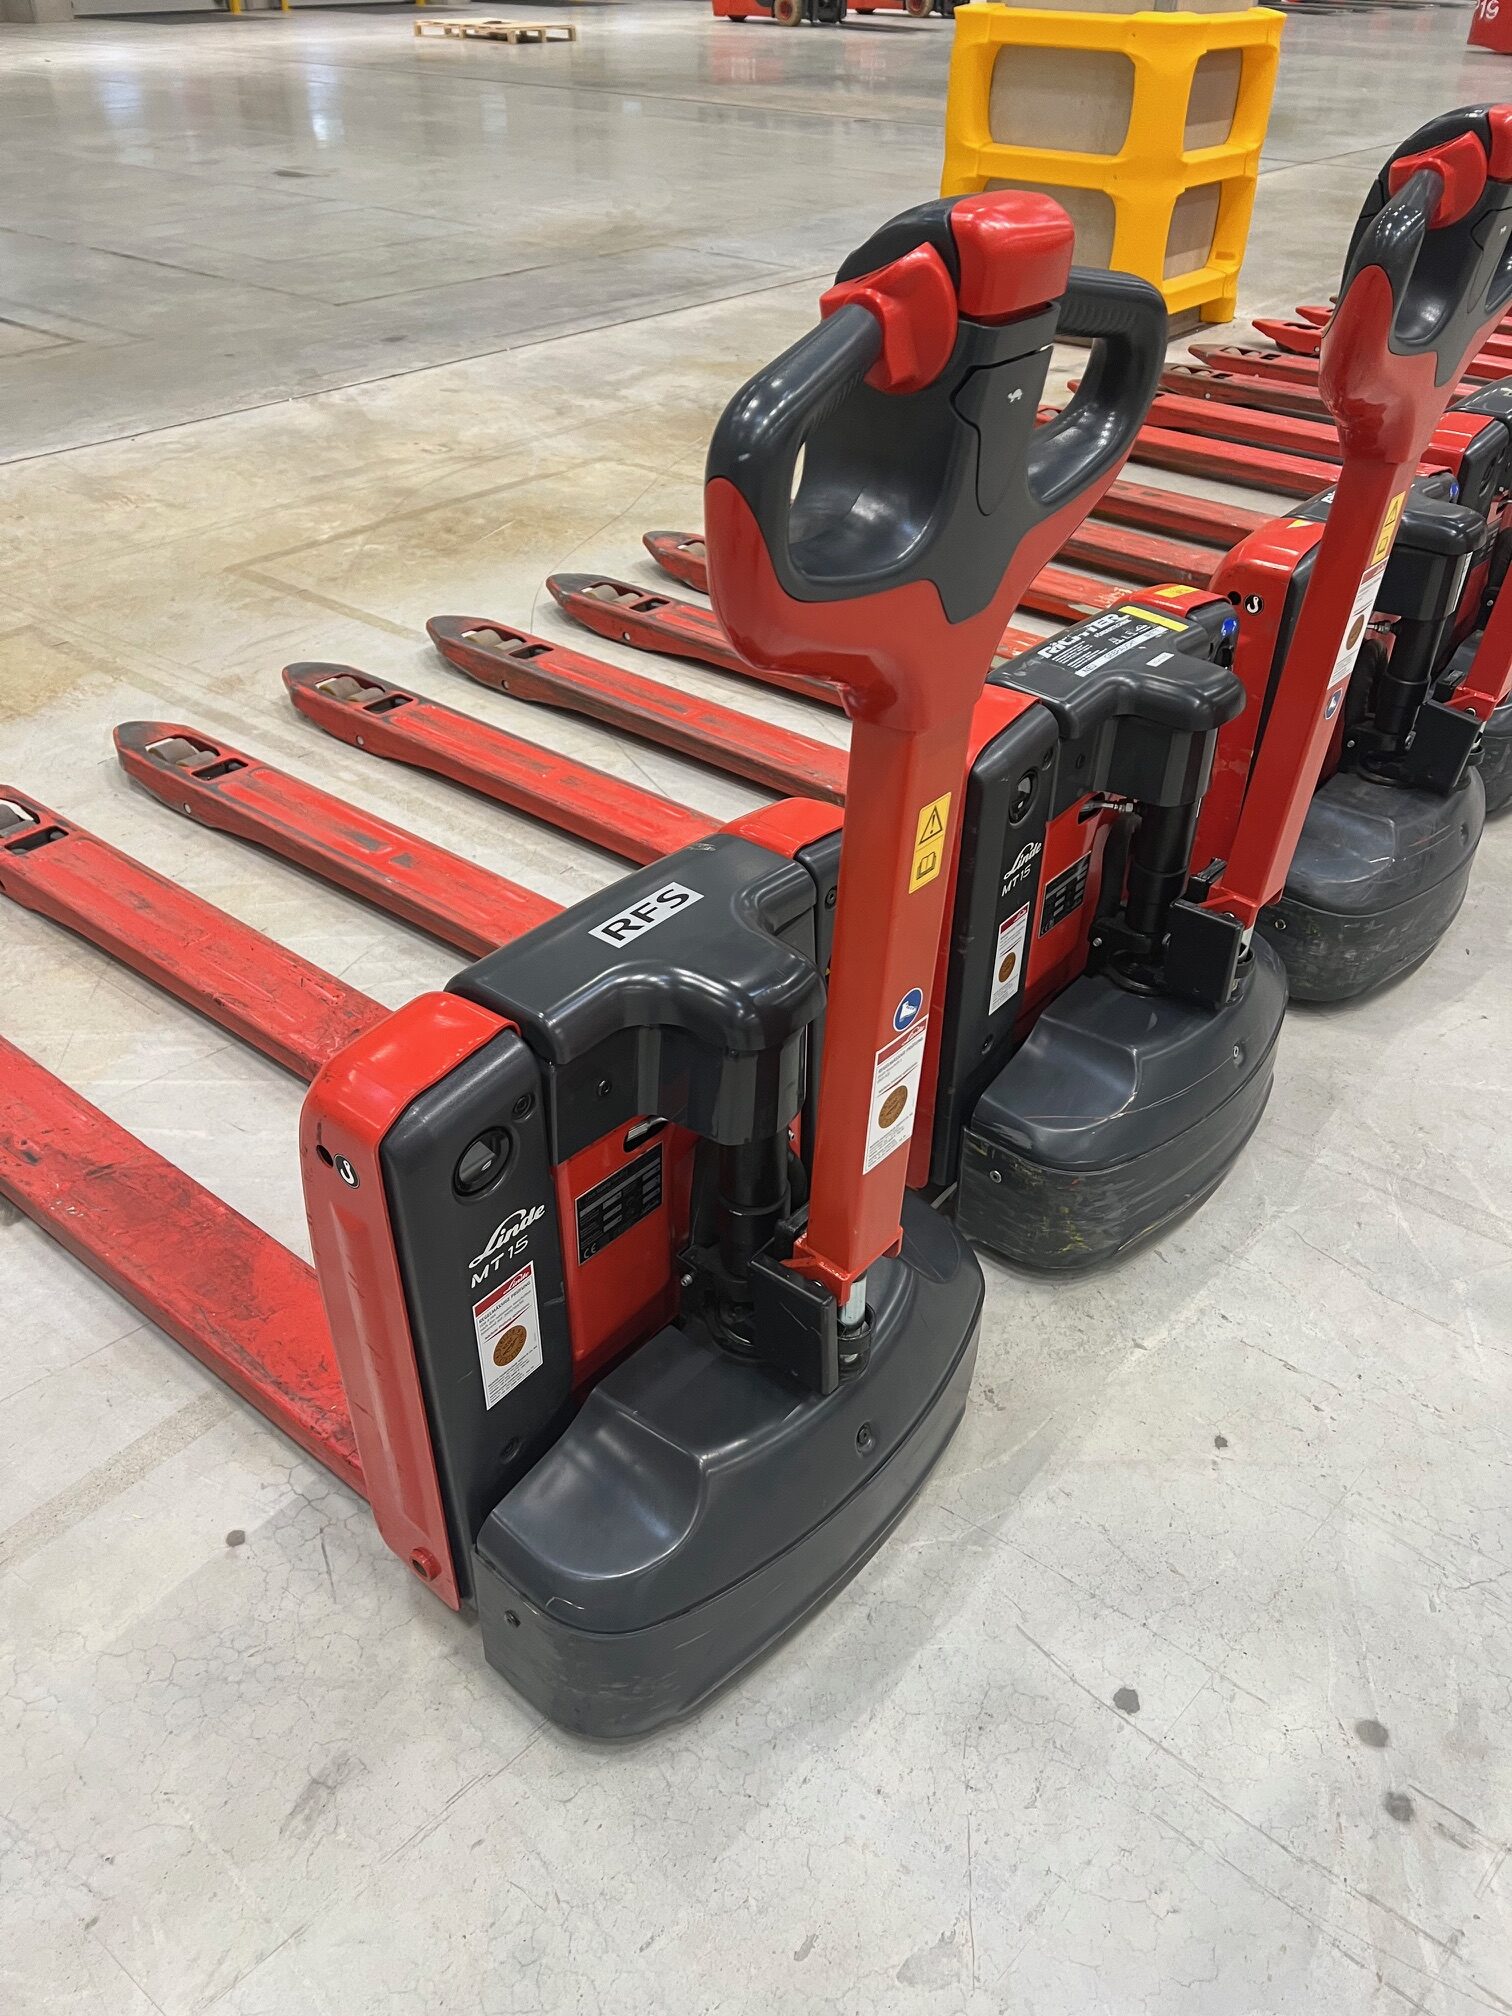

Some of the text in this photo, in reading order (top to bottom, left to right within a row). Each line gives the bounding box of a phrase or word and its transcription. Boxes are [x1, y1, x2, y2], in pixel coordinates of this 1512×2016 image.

[1001, 864, 1032, 897] MT 15
[1003, 842, 1043, 880] Linde
[601, 888, 690, 942] RFS
[468, 1204, 546, 1269] Linde
[471, 1234, 529, 1289] MT 15
